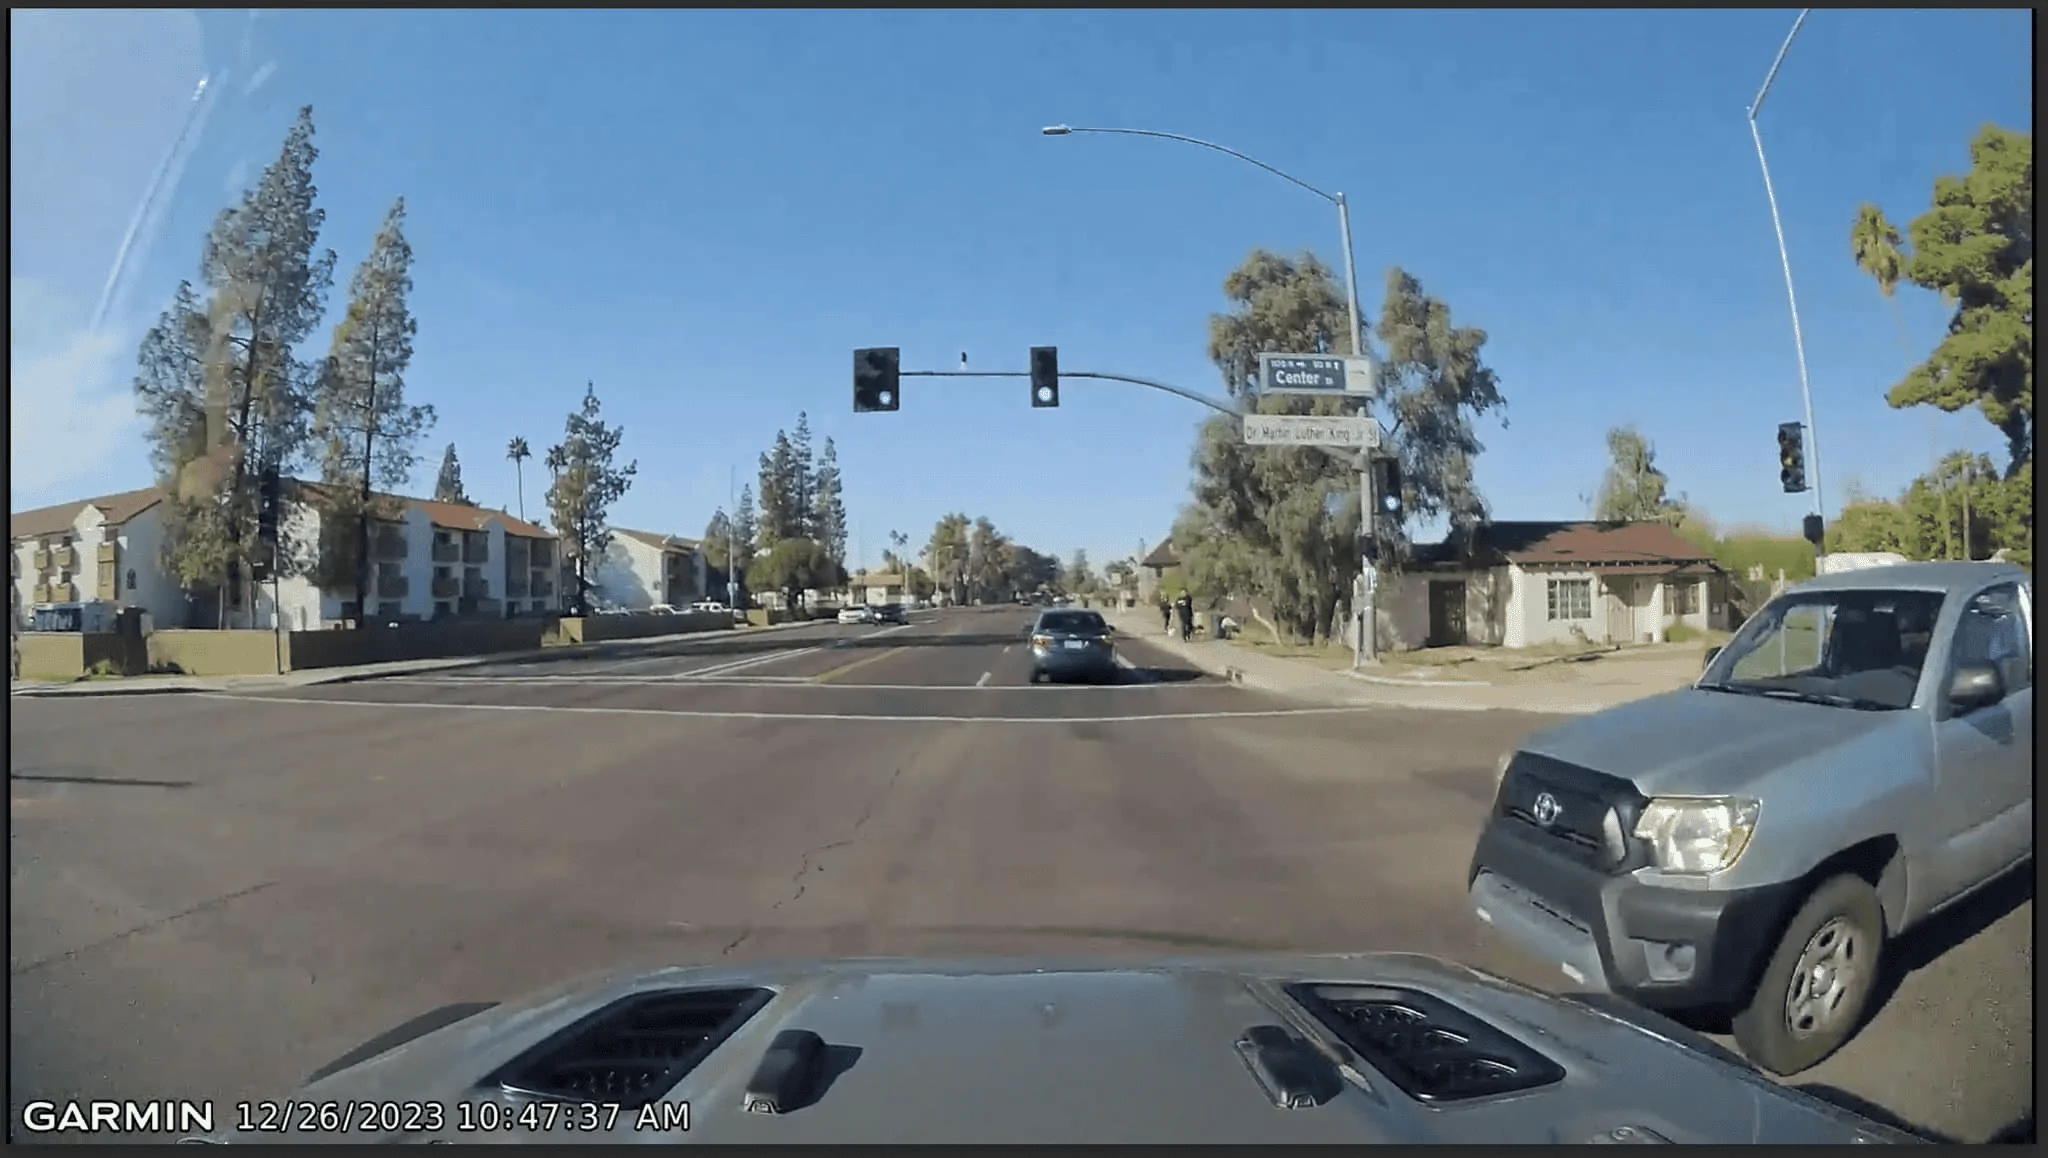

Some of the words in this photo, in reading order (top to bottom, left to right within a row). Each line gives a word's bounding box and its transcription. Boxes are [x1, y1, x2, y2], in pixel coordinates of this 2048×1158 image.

[1275, 370, 1320, 385] Center
[1262, 427, 1290, 439] Martin
[1296, 428, 1324, 440] Luther
[1328, 428, 1350, 442] King
